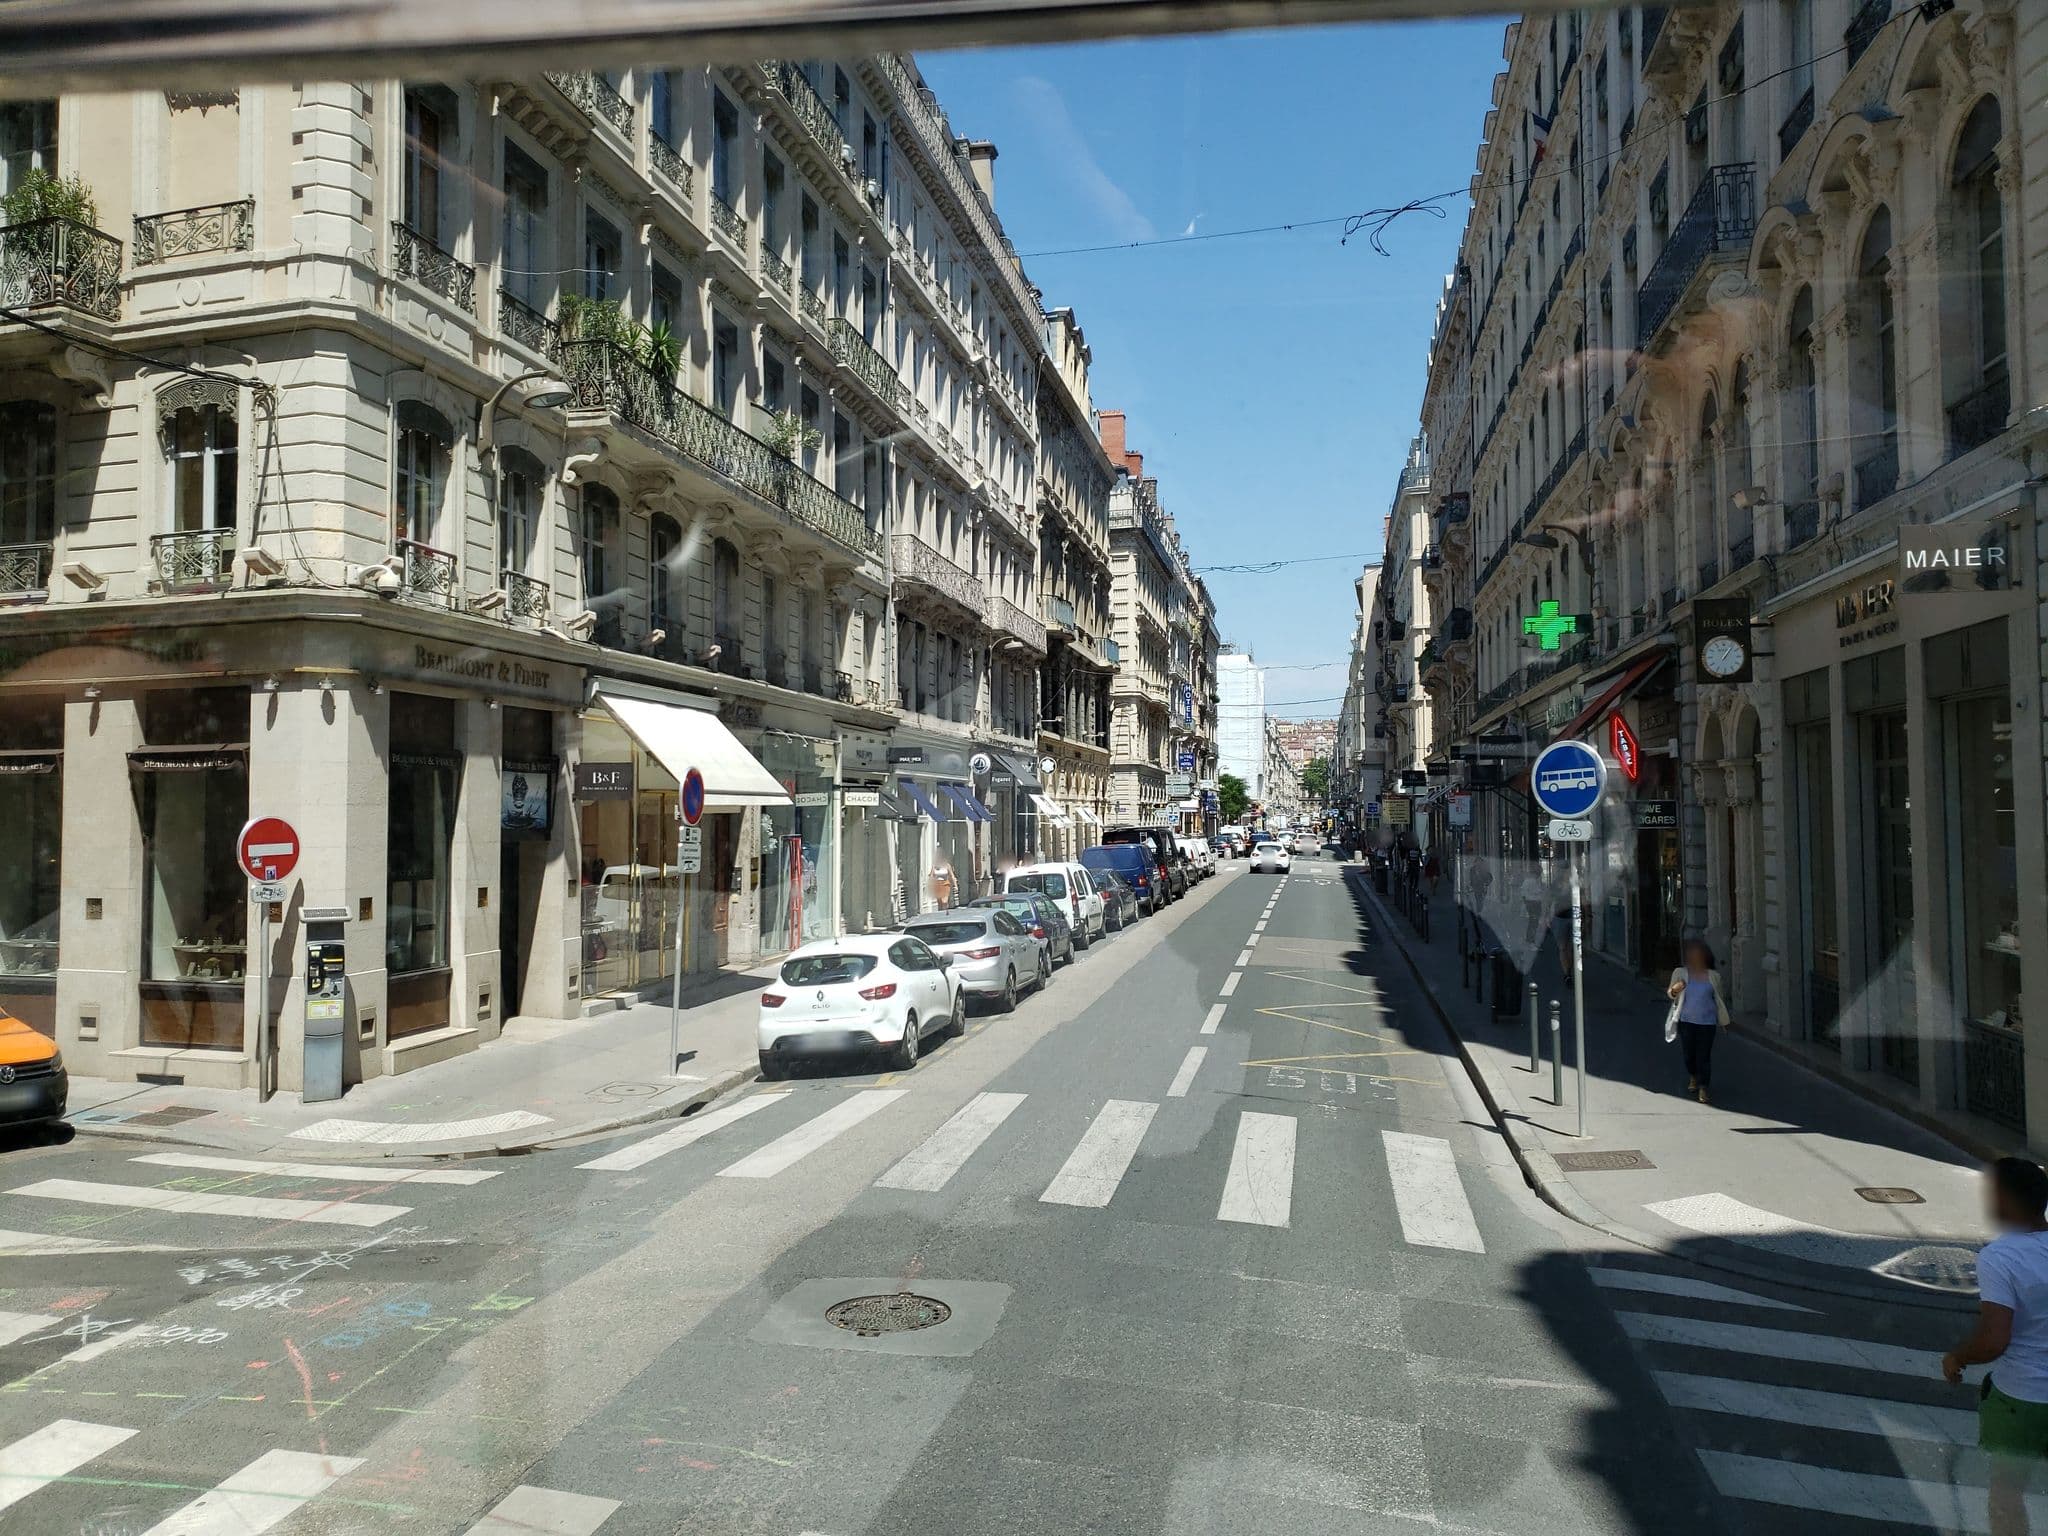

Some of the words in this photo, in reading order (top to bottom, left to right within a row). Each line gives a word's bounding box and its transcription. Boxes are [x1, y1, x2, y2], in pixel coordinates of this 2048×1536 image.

[1906, 547, 2006, 569] MAIER
[1703, 618, 1744, 628] ROLEX
[498, 660, 511, 683] &
[513, 663, 550, 689] FINET
[1184, 684, 1192, 718] HOTEL
[1617, 730, 1633, 765] TABAC
[592, 771, 621, 784] B&F
[846, 795, 878, 803] CHACOK
